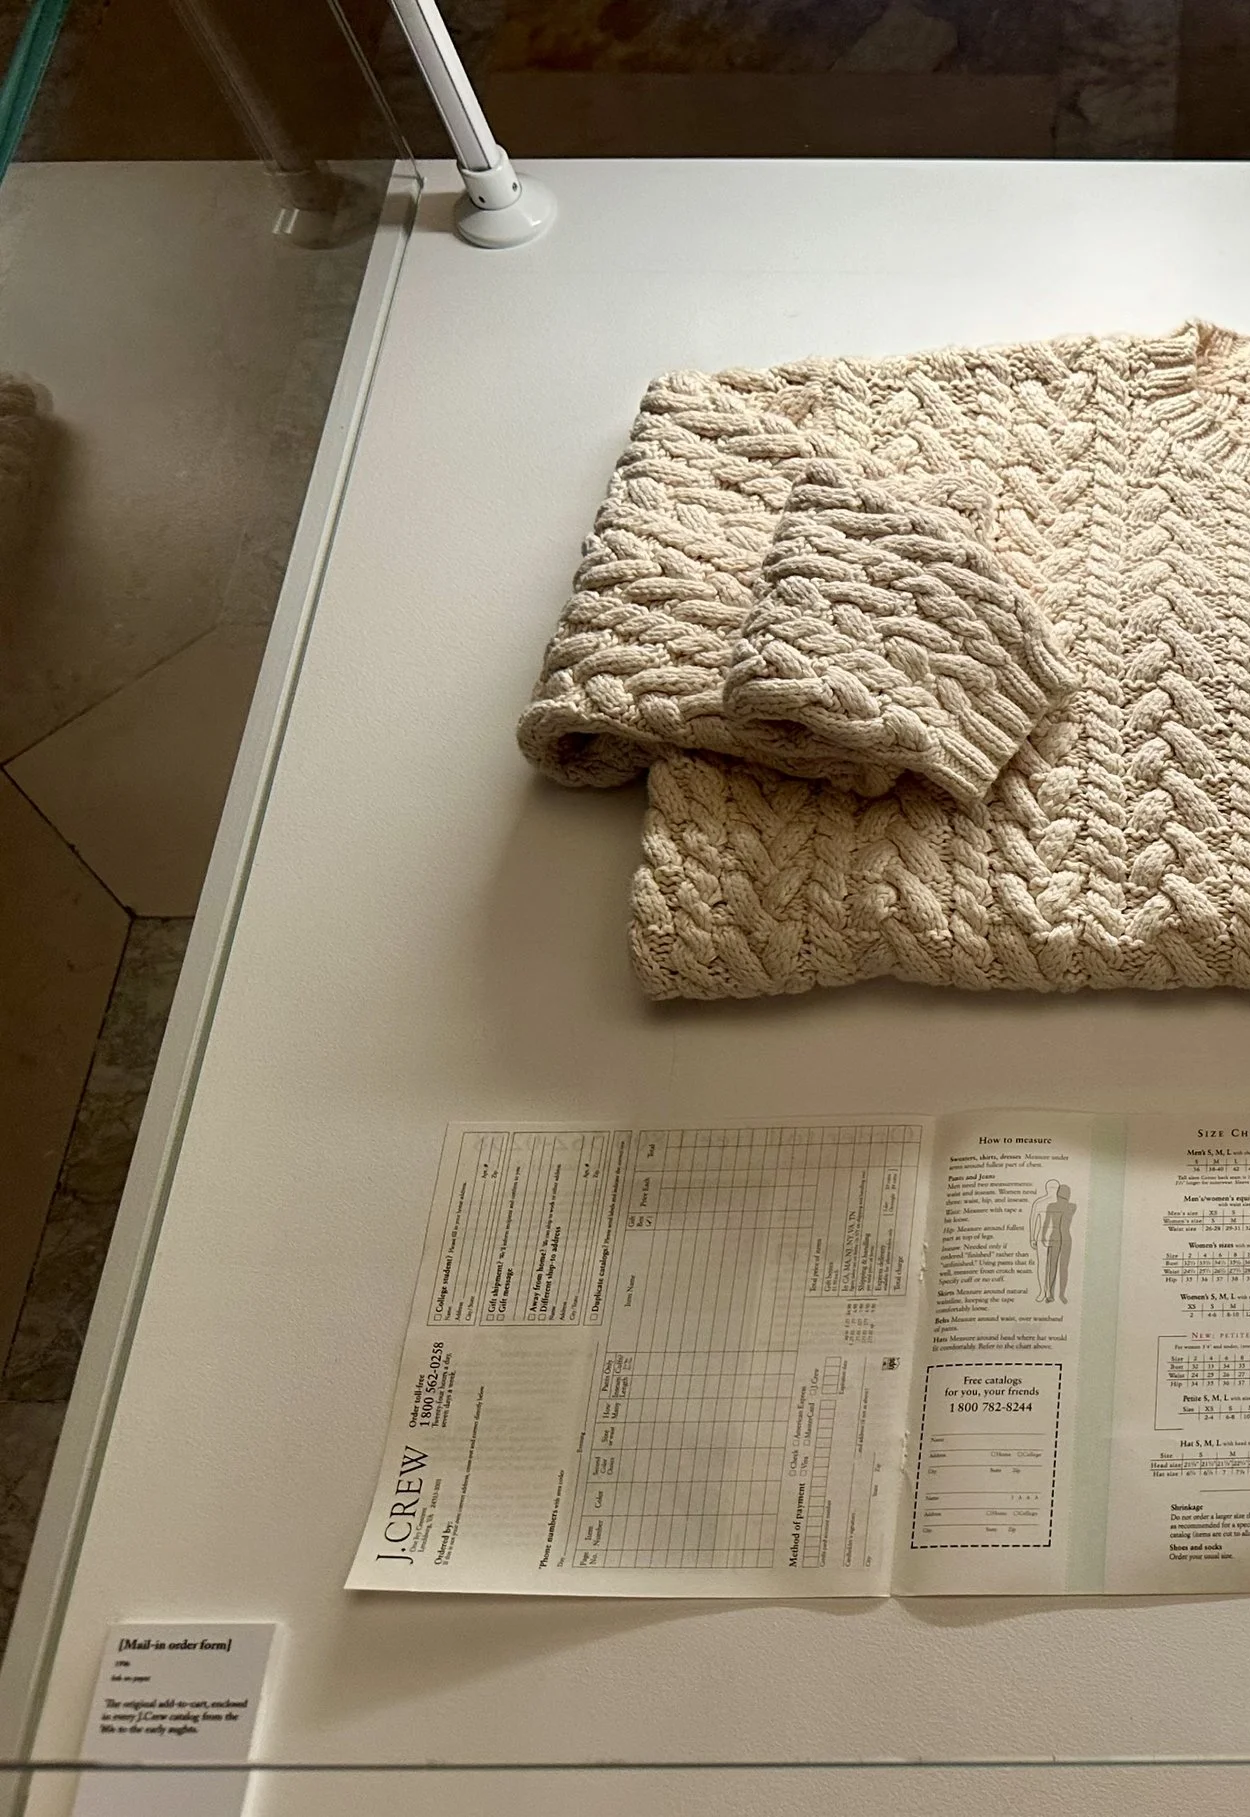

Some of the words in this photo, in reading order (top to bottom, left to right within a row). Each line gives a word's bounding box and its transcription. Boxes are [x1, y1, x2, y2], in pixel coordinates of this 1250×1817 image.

[550, 1226, 561, 1252] address
[441, 1255, 454, 1285] student?
[536, 1249, 547, 1272] home?
[546, 1254, 559, 1280] ship-to
[596, 1244, 609, 1277] catalogs?
[491, 1261, 505, 1297] shipment?
[502, 1268, 514, 1296] message
[533, 1274, 543, 1290] from
[436, 1286, 449, 1312] College
[487, 1298, 499, 1312] Gift
[498, 1298, 508, 1312] Gift
[529, 1292, 541, 1312] Away
[539, 1281, 553, 1312] Different
[591, 1278, 604, 1312] Duplicate
[426, 1342, 444, 1394] 562-0258
[964, 1376, 982, 1385] Free
[985, 1376, 1022, 1386] catalogs
[409, 1406, 419, 1428] Order
[414, 1375, 425, 1403] toll-free
[945, 1388, 958, 1397] for
[961, 1388, 981, 1398] you,
[984, 1388, 1005, 1398] your
[1008, 1387, 1040, 1396] friends
[420, 1397, 434, 1418] 800
[950, 1403, 954, 1413] 1
[958, 1402, 978, 1413] 800
[982, 1402, 1032, 1412] 782-8244
[376, 1446, 428, 1564] J.CREW
[794, 1483, 807, 1519] payment
[441, 1521, 453, 1533] by:
[546, 1510, 558, 1542] numbers
[793, 1521, 801, 1530] of
[434, 1535, 449, 1565] Ordered
[788, 1533, 801, 1567] Method
[118, 1639, 166, 1652] [Mail-in
[168, 1639, 199, 1650] order
[200, 1639, 232, 1652] form]
